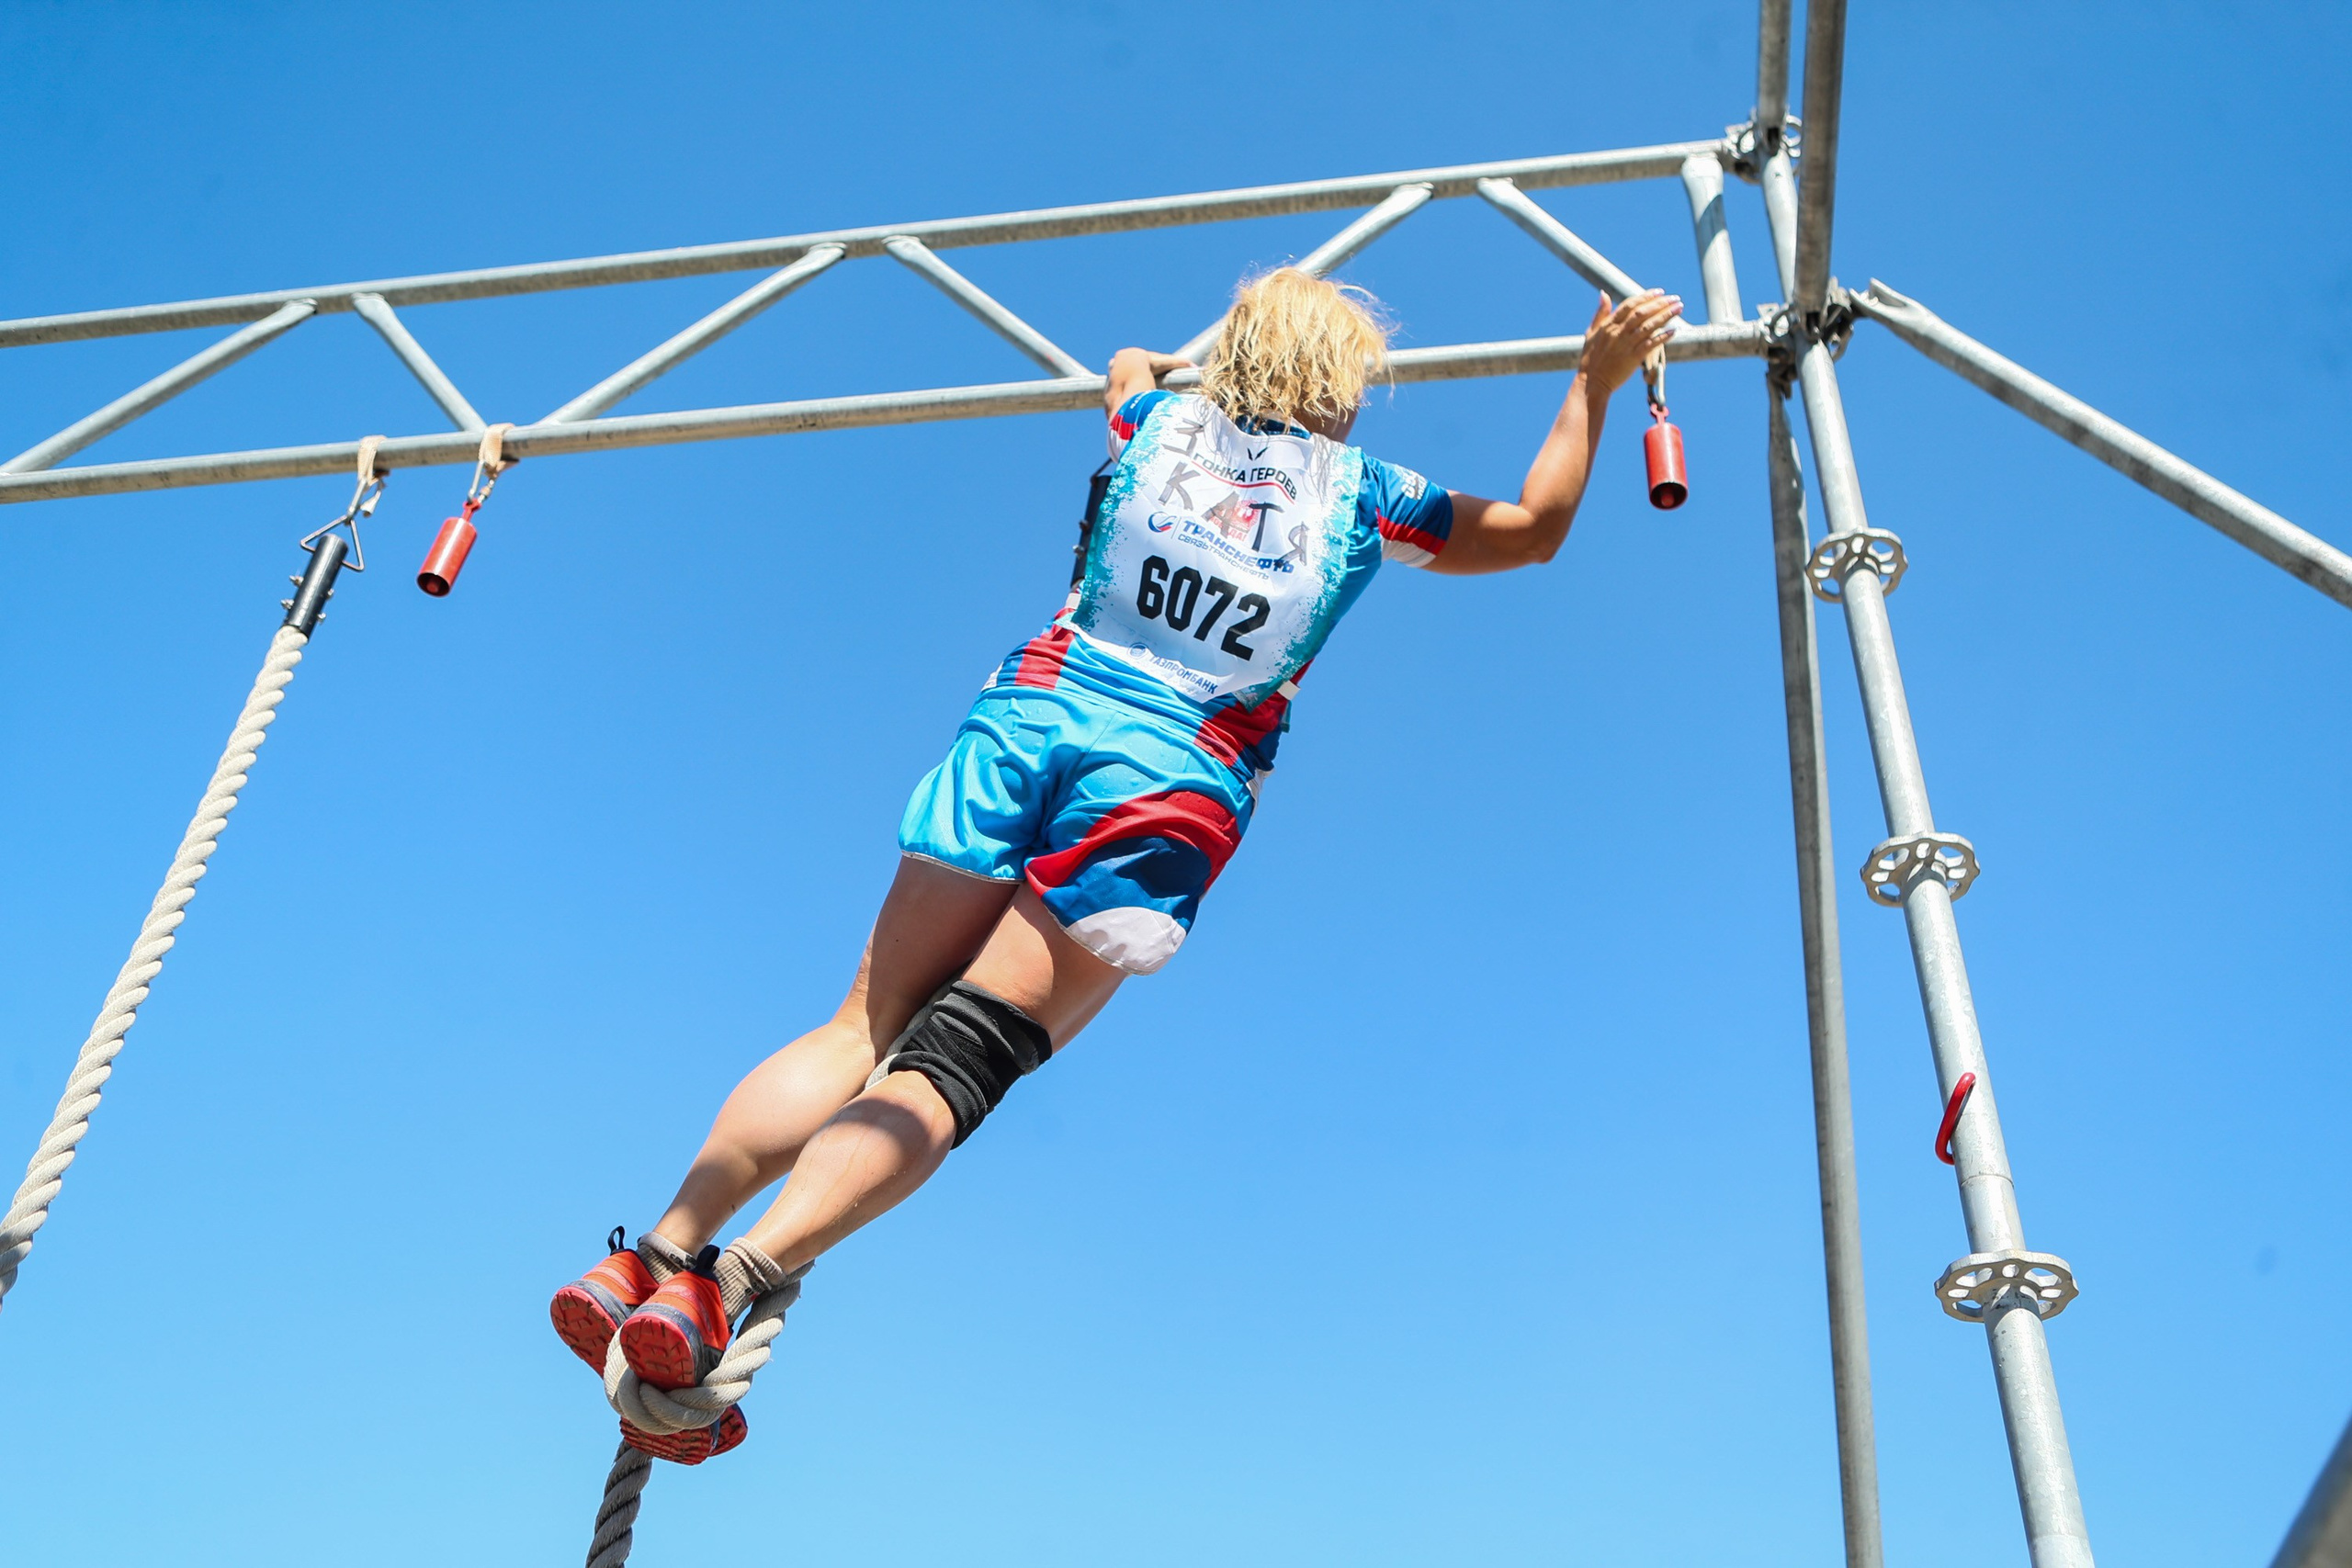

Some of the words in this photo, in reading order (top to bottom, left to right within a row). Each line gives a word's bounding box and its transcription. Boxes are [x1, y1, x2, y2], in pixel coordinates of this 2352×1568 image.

[1193, 453, 1246, 482] ГОНКА
[1250, 467, 1297, 501] ГЕРОЕВ
[1177, 534, 1270, 581] СВЯЗЬТРАНСНЕФТЬ
[1183, 520, 1295, 574] ТРАНСНЕФТЬ
[1136, 555, 1271, 661] 6072
[1148, 656, 1218, 694] ГАЗПРОМБАНК
